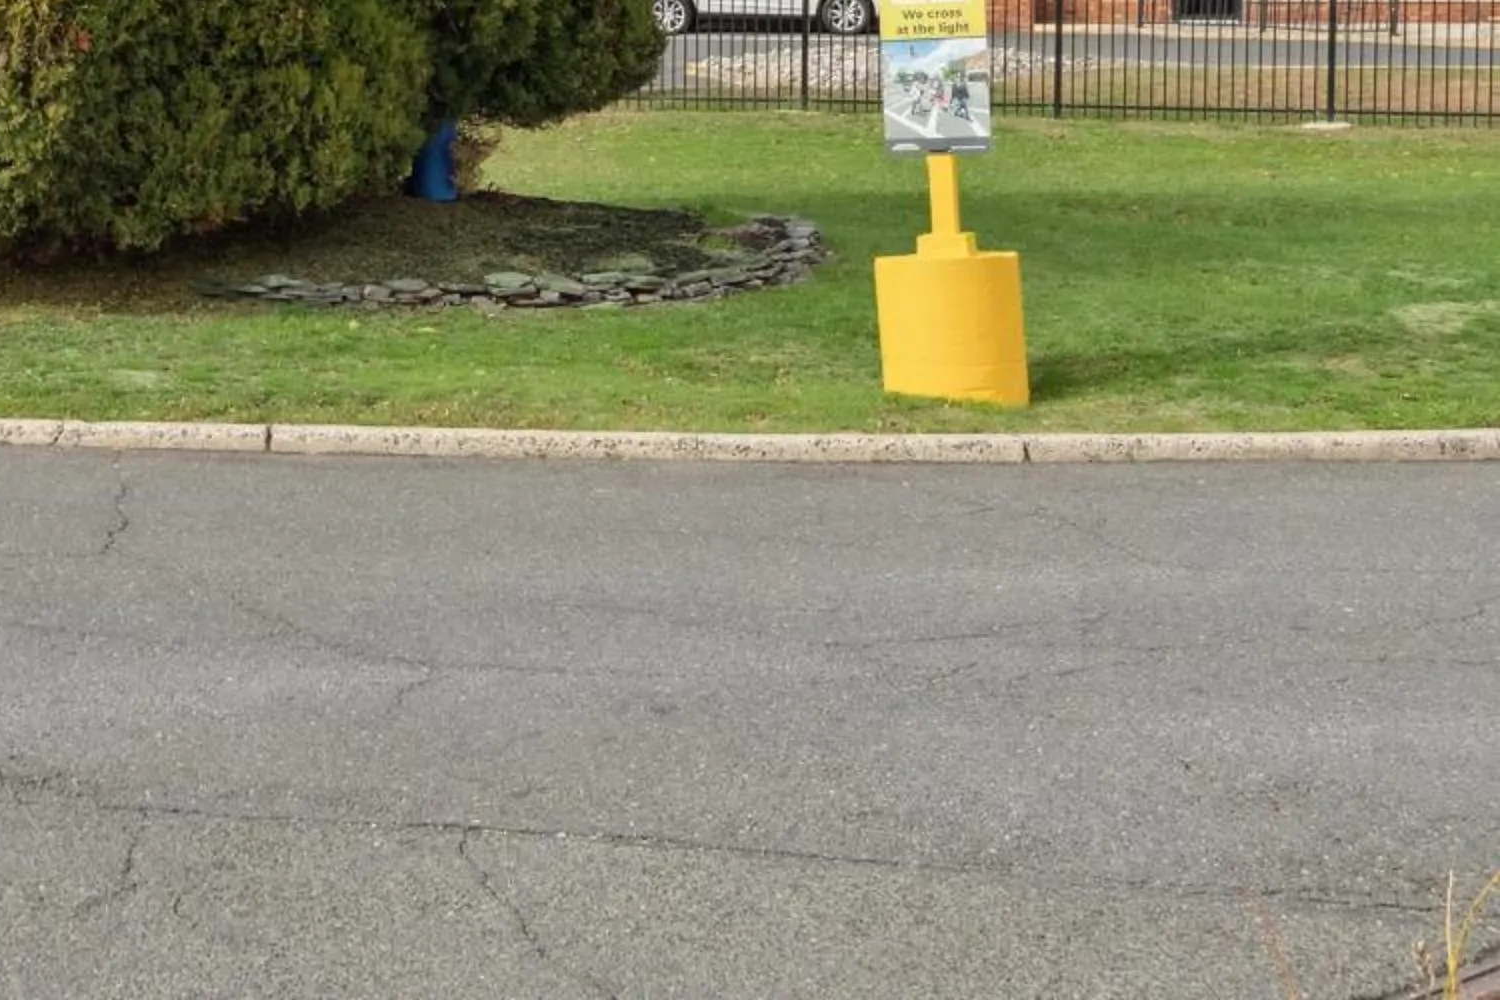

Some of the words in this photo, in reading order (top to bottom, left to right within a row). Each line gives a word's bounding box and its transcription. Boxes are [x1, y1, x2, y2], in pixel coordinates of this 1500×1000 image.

[901, 9, 923, 20] We
[927, 8, 963, 19] cross
[897, 25, 909, 35] at
[913, 23, 935, 34] the
[939, 22, 970, 34] light
